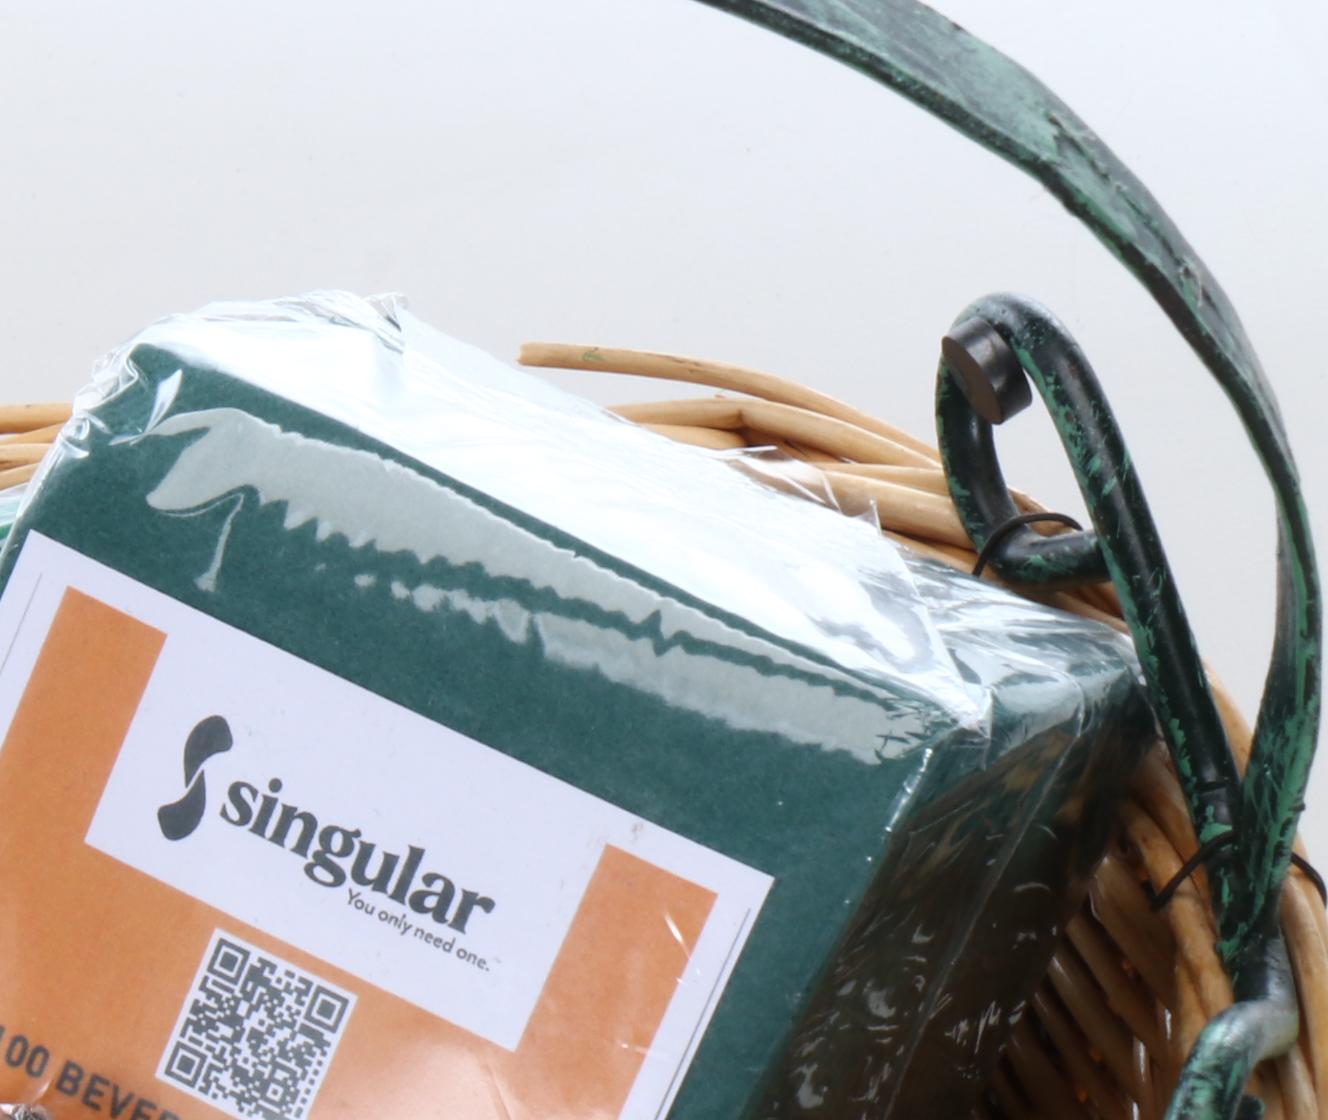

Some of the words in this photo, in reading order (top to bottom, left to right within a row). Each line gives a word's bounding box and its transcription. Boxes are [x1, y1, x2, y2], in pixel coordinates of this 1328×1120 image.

[218, 777, 496, 935] singular
[346, 888, 375, 915] You
[378, 914, 412, 936] only
[413, 926, 456, 953] need
[456, 947, 491, 972] one.
